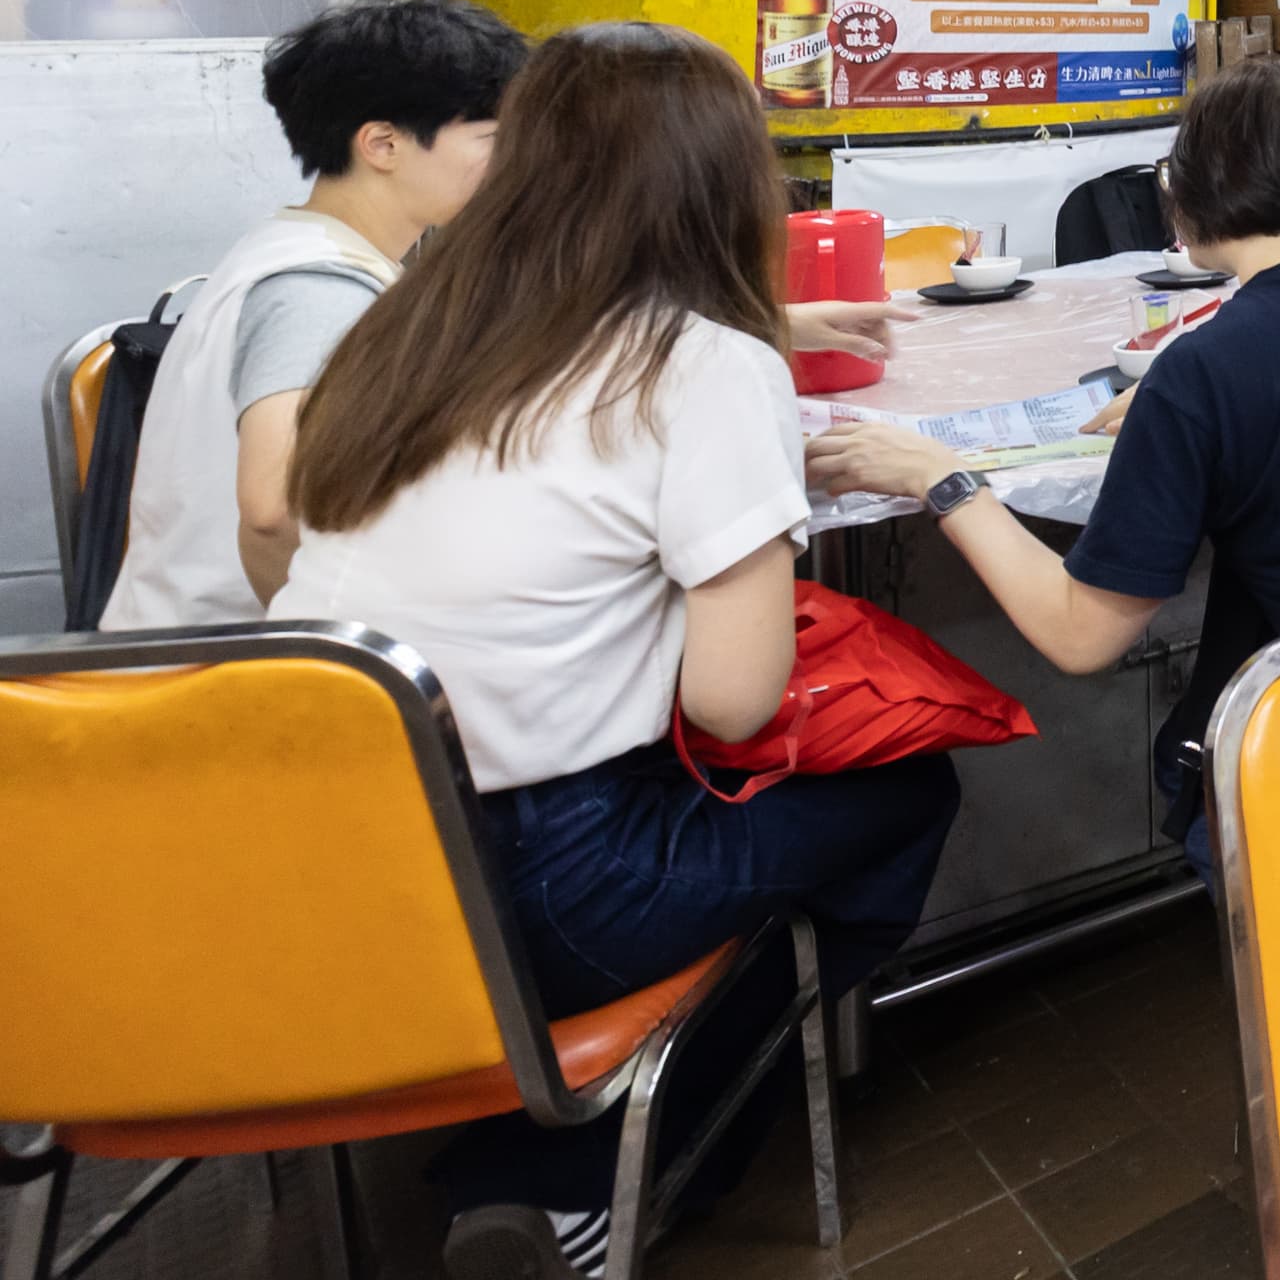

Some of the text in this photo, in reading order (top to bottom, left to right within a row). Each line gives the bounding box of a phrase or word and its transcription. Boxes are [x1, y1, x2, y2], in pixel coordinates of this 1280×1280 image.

[832, 4, 893, 24] BREWED IN
[834, 42, 893, 63] HONG KONG
